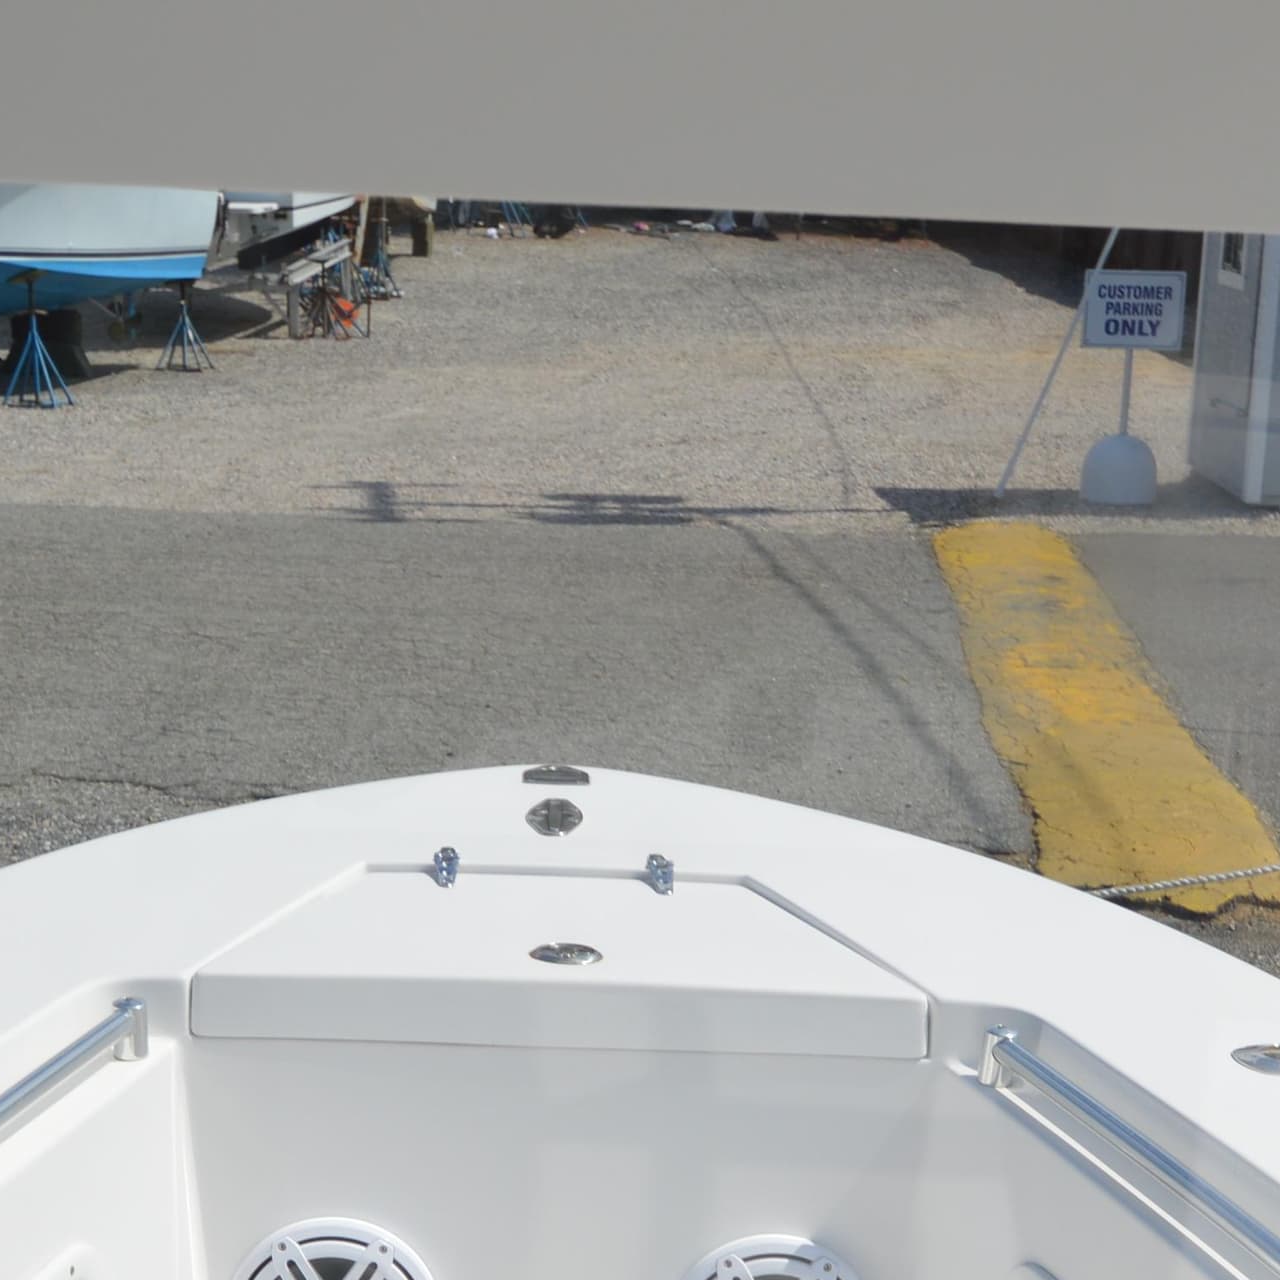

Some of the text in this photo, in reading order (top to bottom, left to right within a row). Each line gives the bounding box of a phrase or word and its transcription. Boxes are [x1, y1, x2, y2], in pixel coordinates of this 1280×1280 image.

[1098, 284, 1173, 301] CUSTOMER
[1105, 302, 1163, 317] PARKING
[1104, 318, 1160, 337] ONLY
